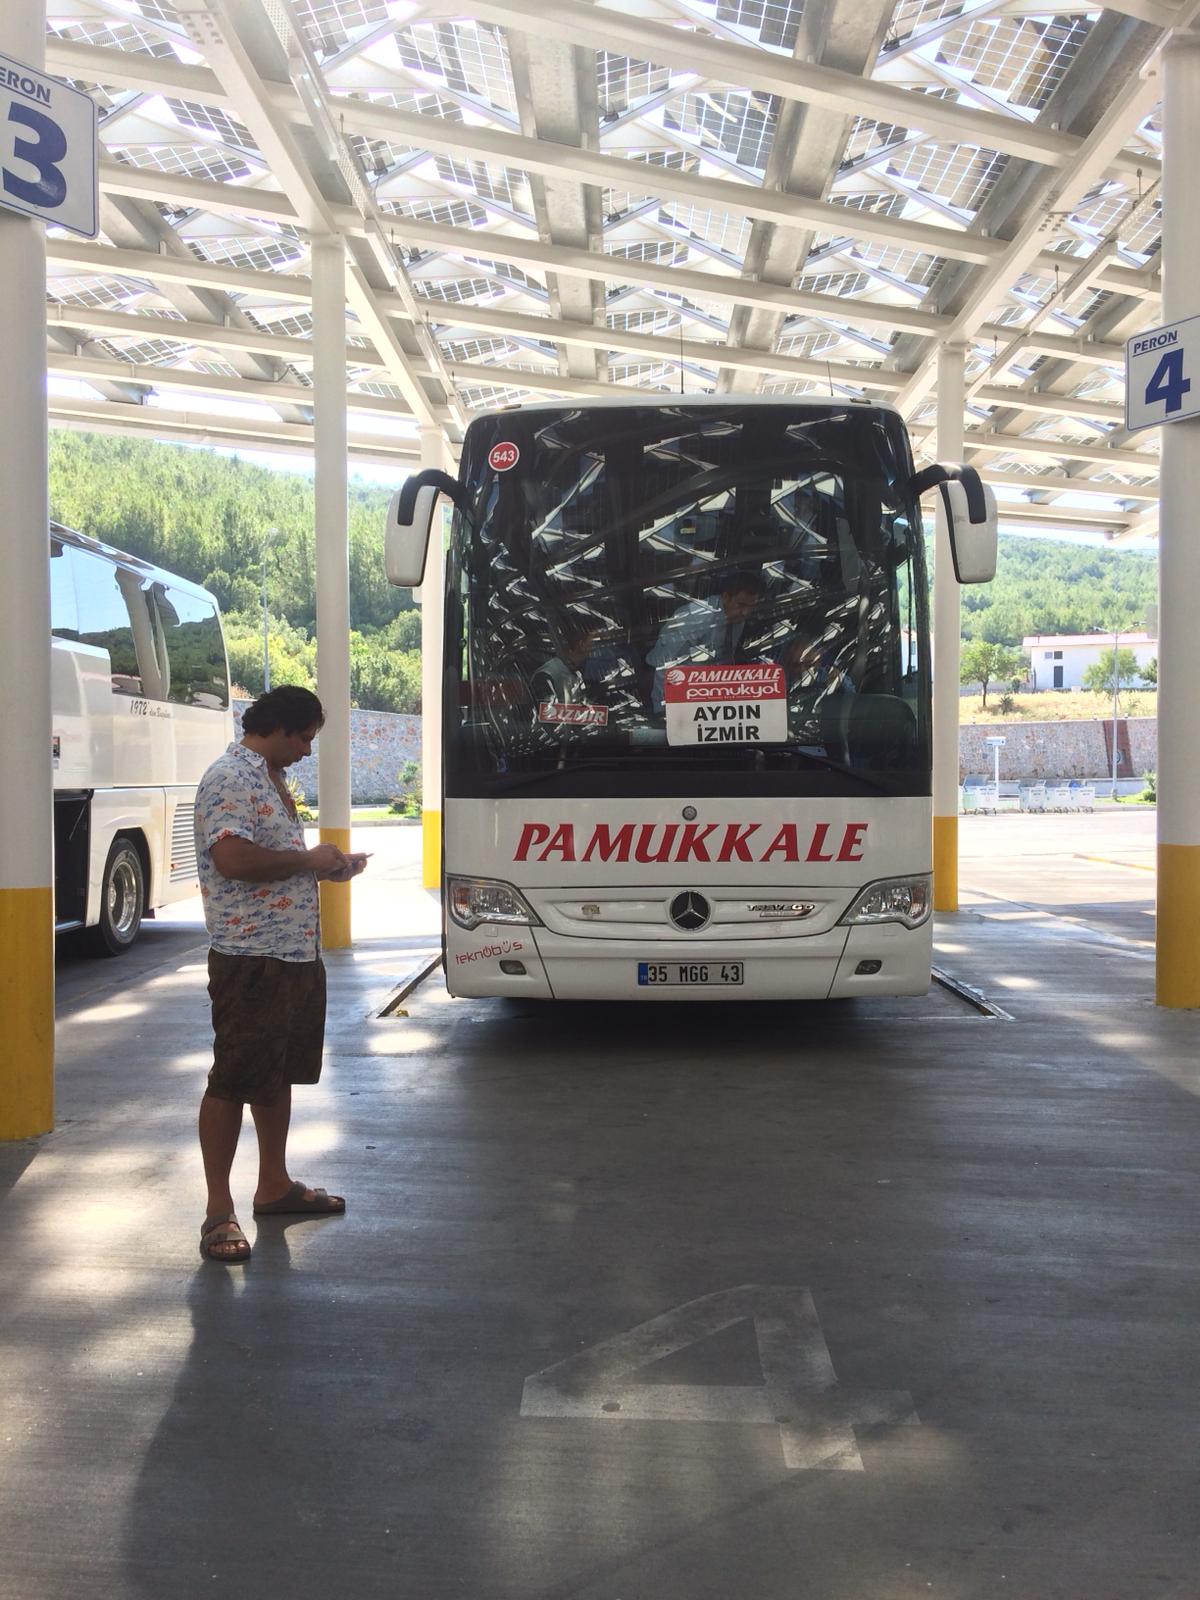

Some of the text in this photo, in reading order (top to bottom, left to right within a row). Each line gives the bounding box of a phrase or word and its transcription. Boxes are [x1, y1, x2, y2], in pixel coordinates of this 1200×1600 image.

[0, 68, 51, 103] ERON
[2, 101, 68, 208] 3
[1133, 330, 1178, 354] PERON
[1145, 348, 1190, 414] 4
[493, 450, 515, 463] 543
[688, 668, 782, 682] PAMUKKALE
[686, 683, 780, 700] pamukyol
[693, 705, 761, 721] AYDIN
[697, 722, 760, 742] İZMİR
[512, 823, 869, 864] PAMUKKALE
[648, 965, 740, 982] 35 MGG 43
[520, 1284, 921, 1471] 4
